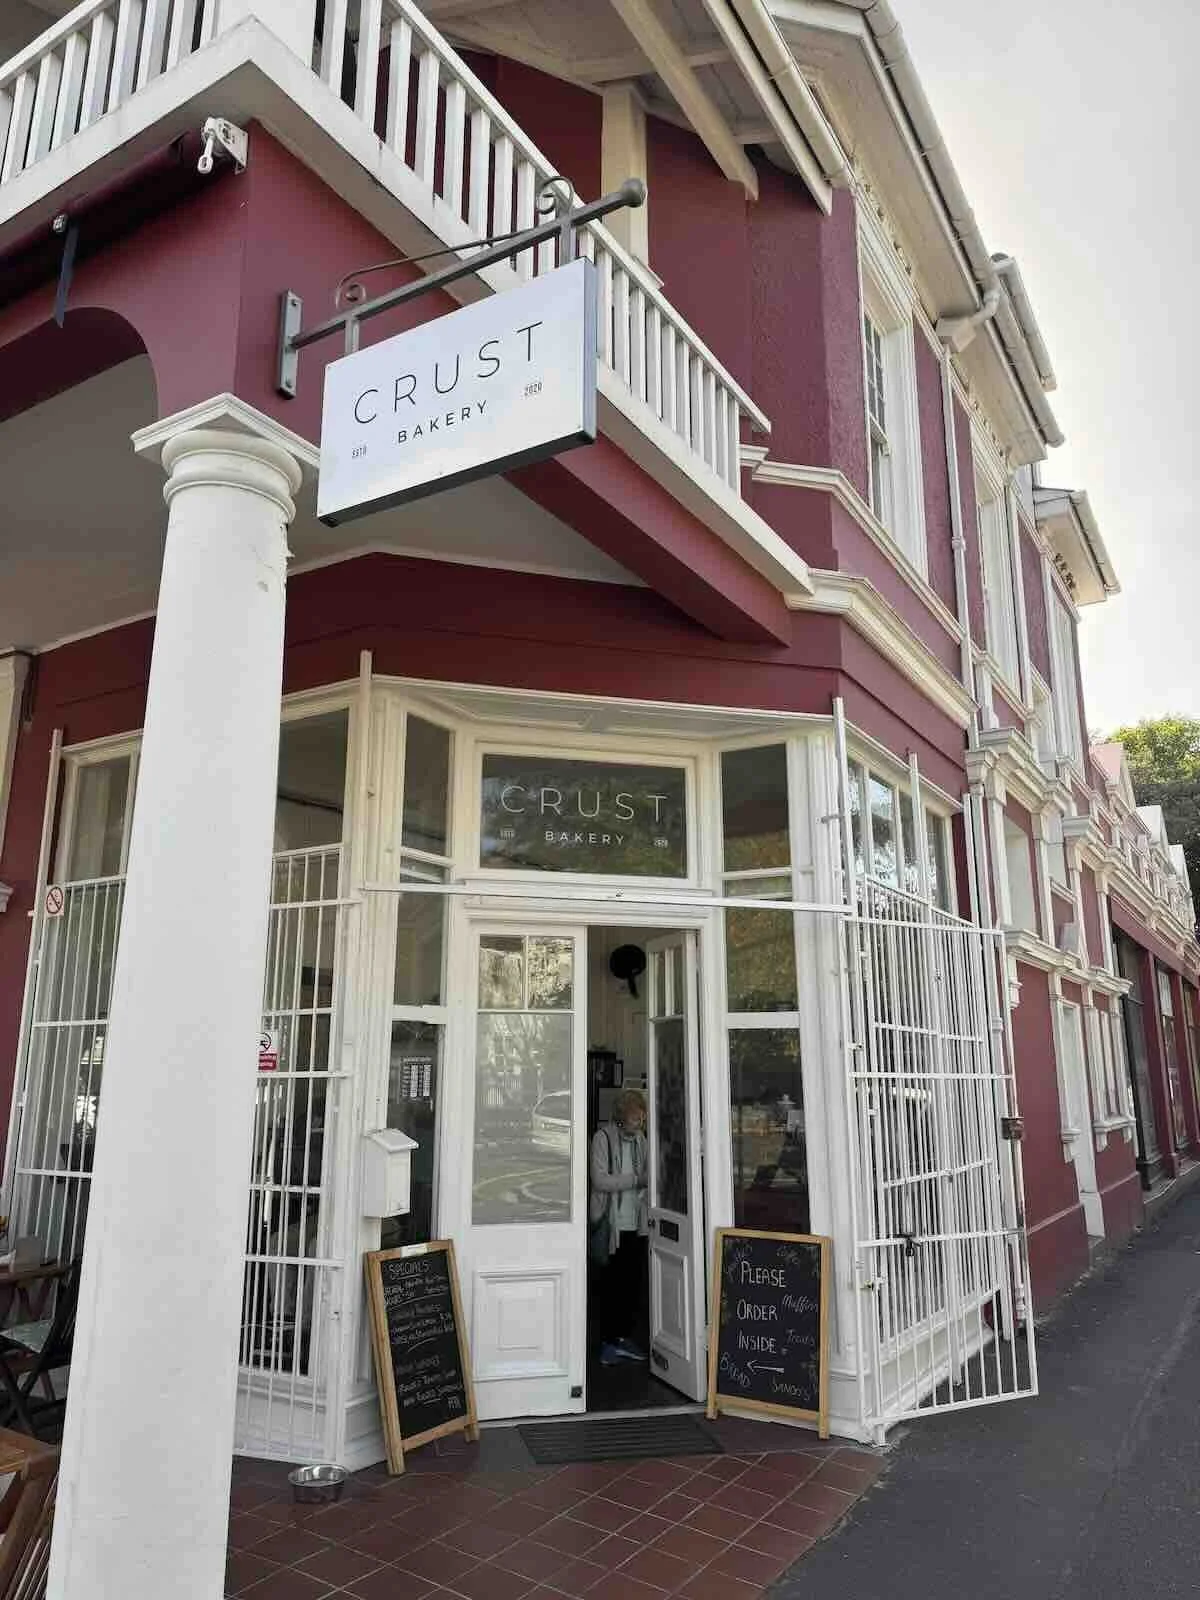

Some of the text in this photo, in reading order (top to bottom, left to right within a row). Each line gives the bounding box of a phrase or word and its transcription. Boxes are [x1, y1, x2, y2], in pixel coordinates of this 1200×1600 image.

[353, 320, 544, 425] CRUST
[397, 399, 489, 443] BAKERY
[500, 785, 668, 823] CRUST
[545, 830, 625, 845] BAKERY
[740, 1260, 787, 1288] PLEASE
[736, 1298, 778, 1321] ORDER
[737, 1329, 777, 1354] INSIDE
